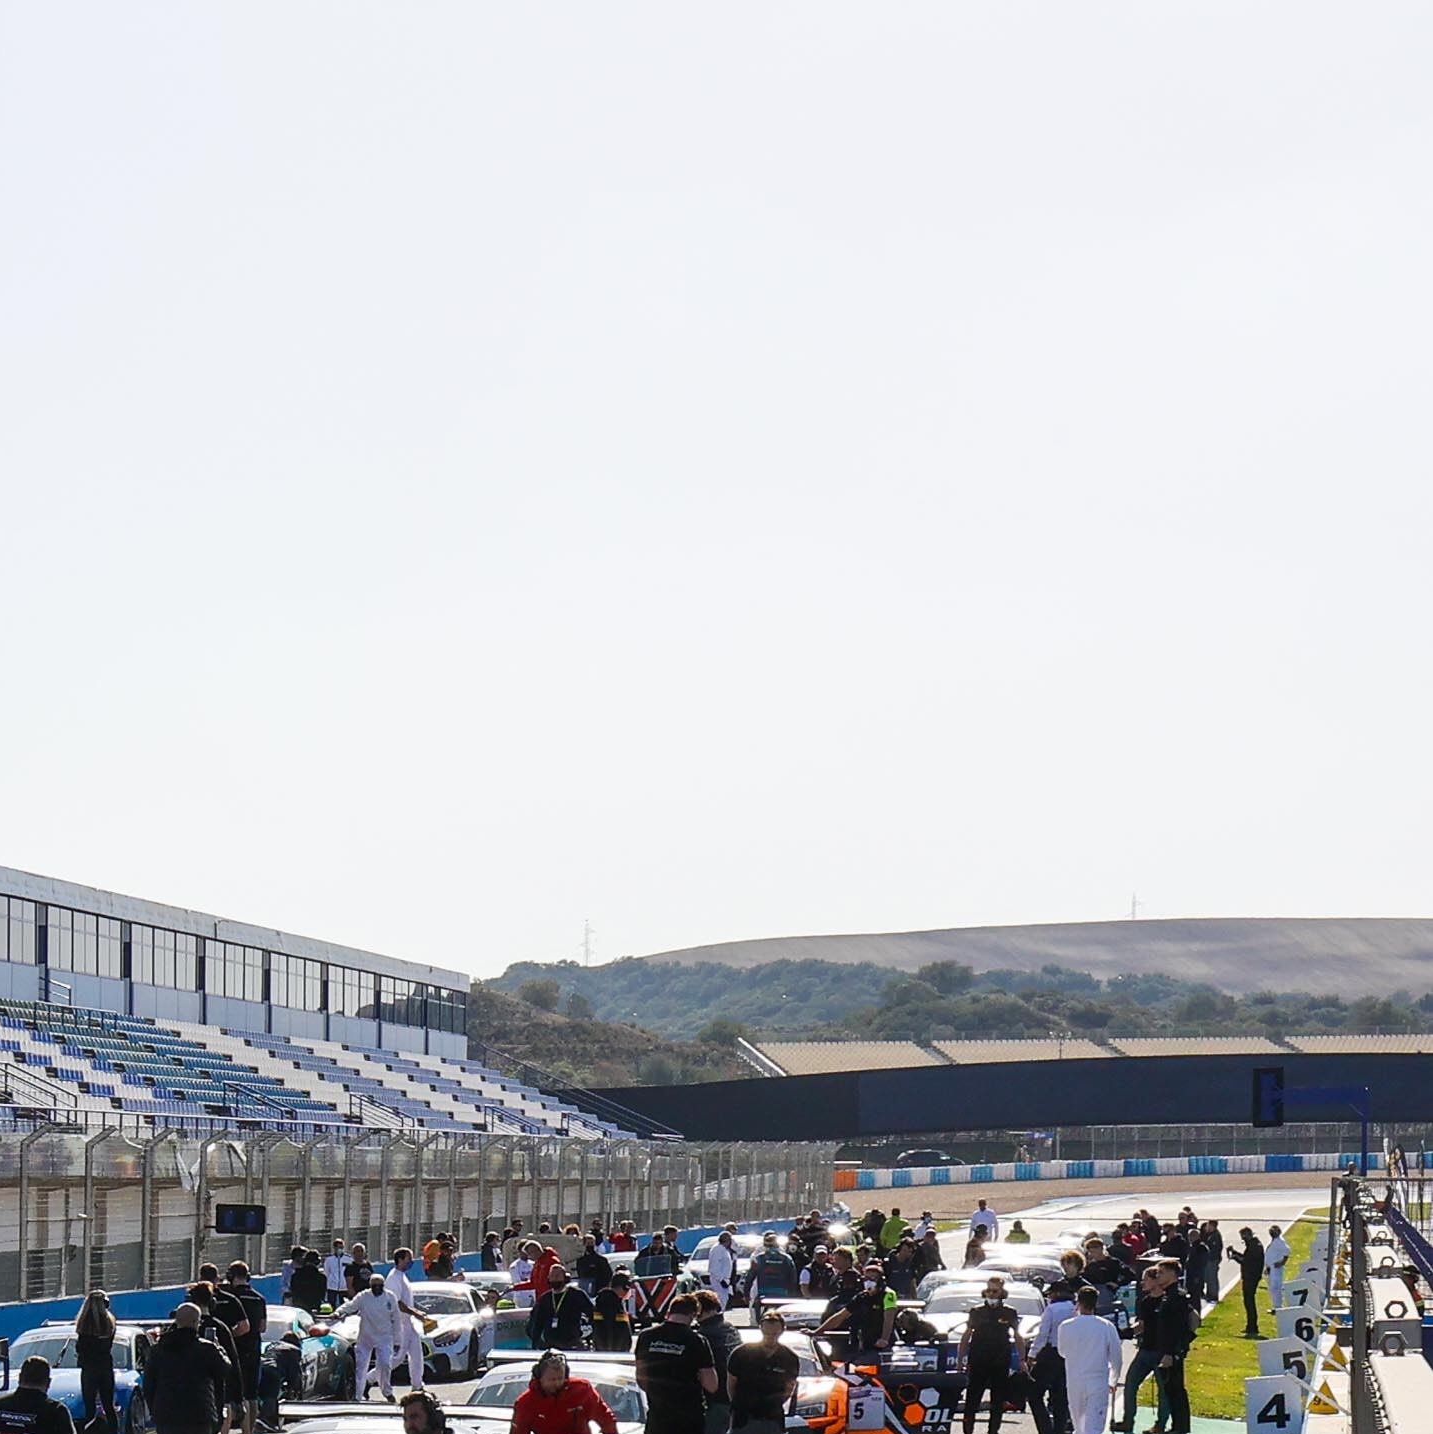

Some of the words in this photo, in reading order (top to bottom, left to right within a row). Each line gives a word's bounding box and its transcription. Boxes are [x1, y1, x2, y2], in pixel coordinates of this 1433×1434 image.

[1292, 1288, 1309, 1306] 7
[1294, 1317, 1315, 1342] 6
[1282, 1350, 1307, 1380] 5
[853, 1403, 865, 1420] 5
[1256, 1393, 1291, 1428] 4
